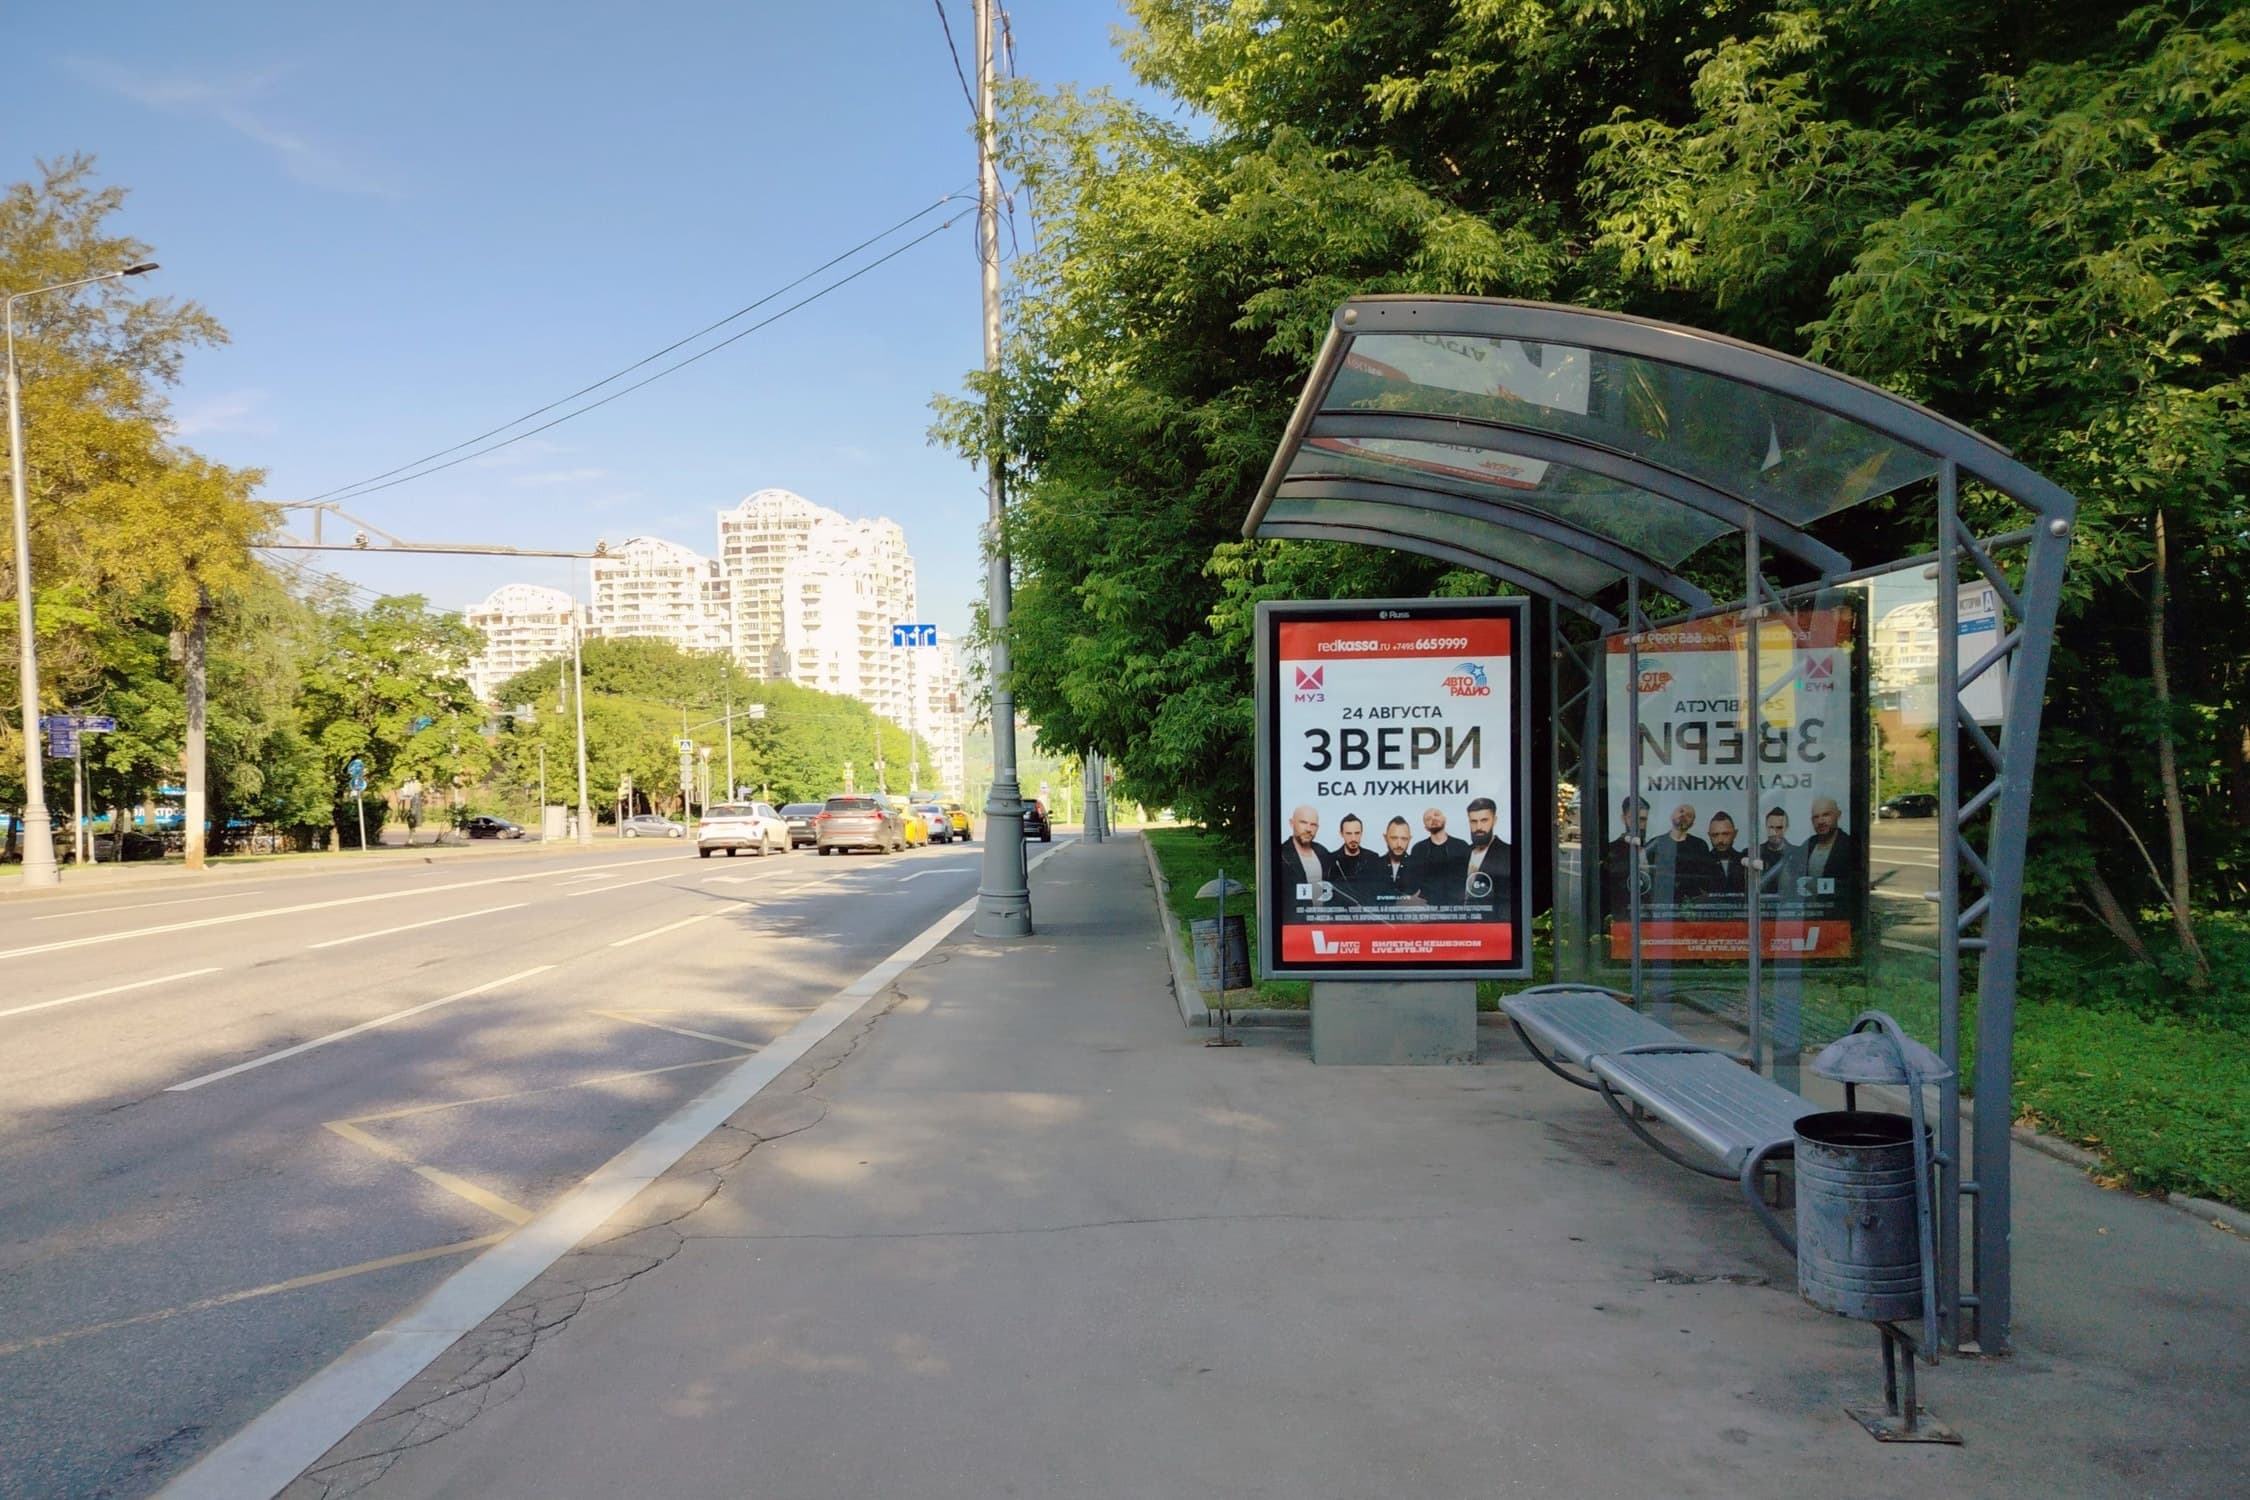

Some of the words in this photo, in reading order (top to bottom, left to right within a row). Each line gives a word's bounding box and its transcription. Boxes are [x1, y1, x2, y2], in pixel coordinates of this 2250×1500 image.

[1318, 639, 1390, 652] redkassa.ru
[1441, 675, 1474, 687] АВТО
[1294, 693, 1325, 703] МУЗ
[1450, 686, 1491, 697] РАДИО
[1342, 706, 1363, 720] 24
[1368, 705, 1442, 719] АВГУСТА
[1303, 726, 1482, 772] ЗВЕРИ
[1317, 781, 1356, 797] БСА
[1362, 779, 1469, 796] ЛУЖНИКИ
